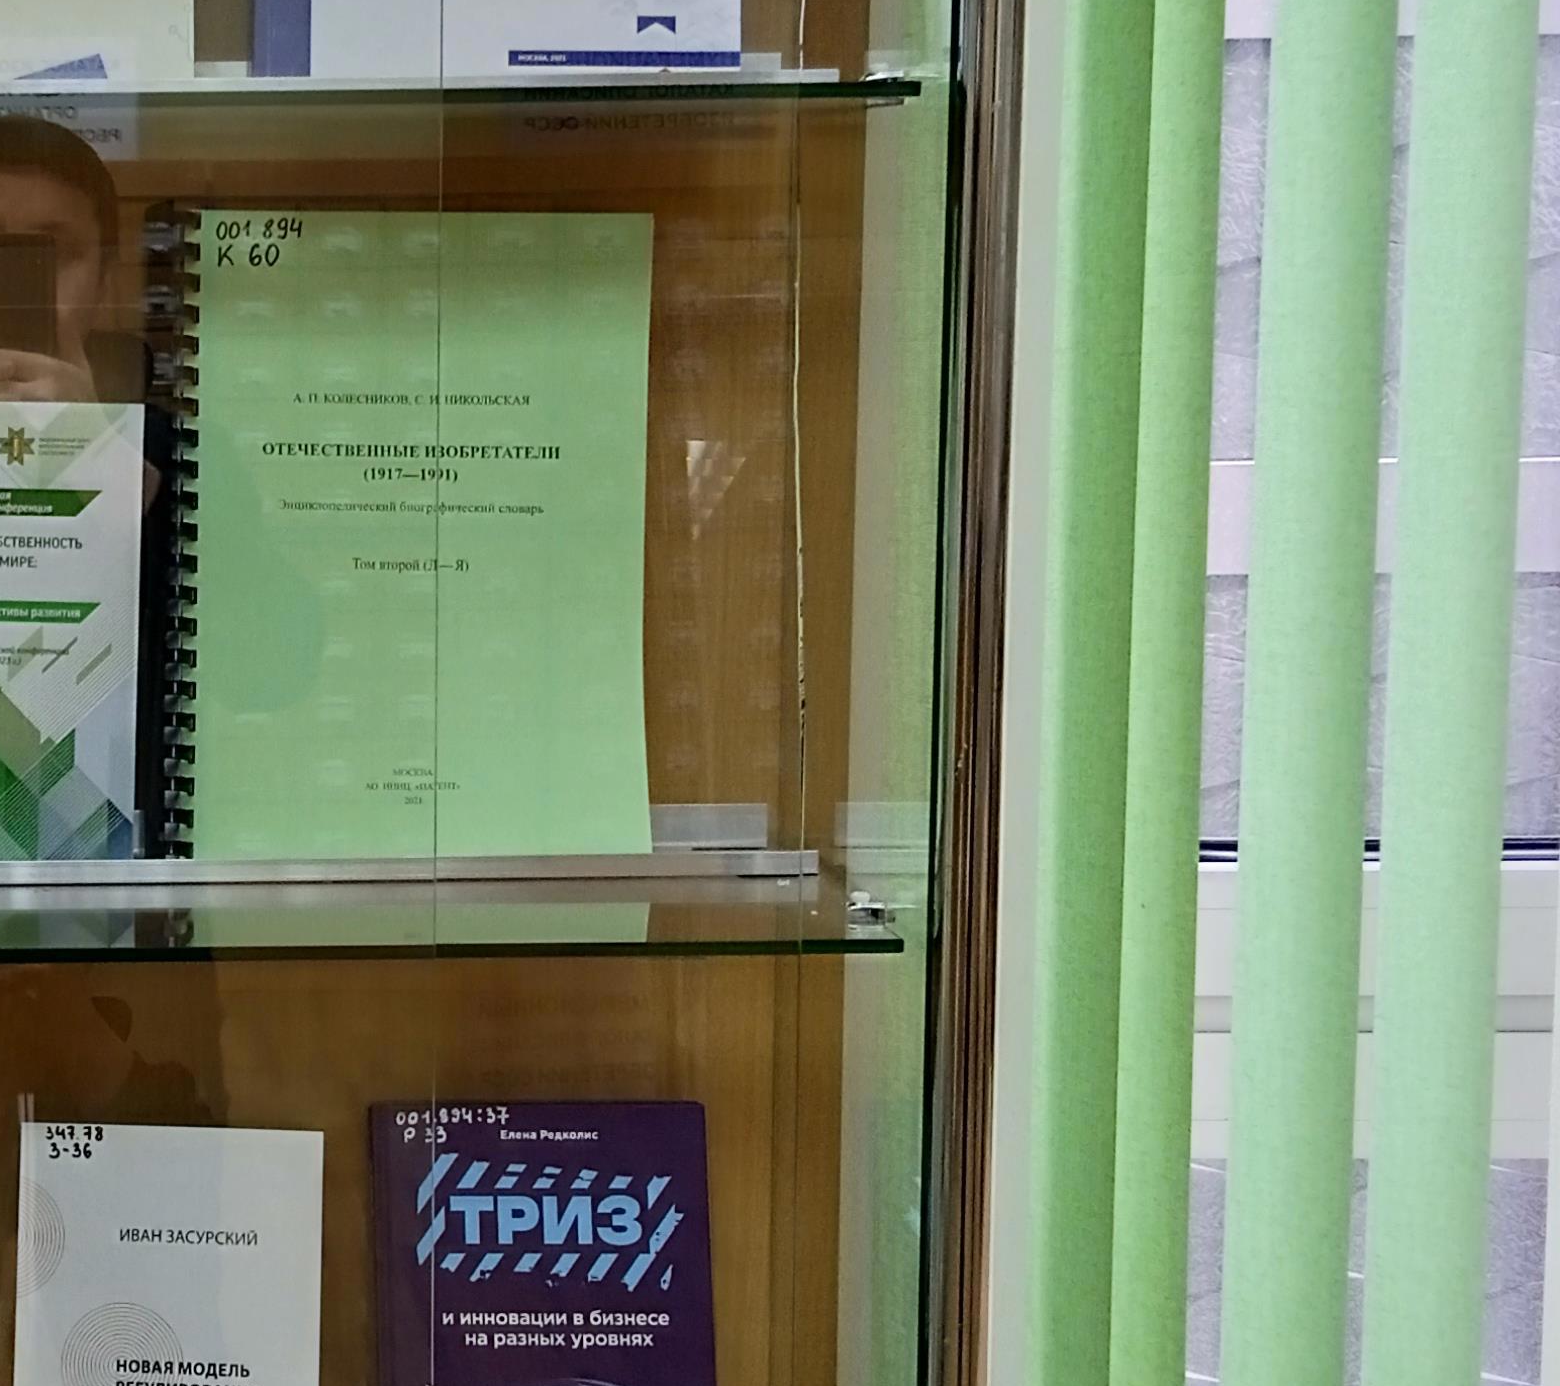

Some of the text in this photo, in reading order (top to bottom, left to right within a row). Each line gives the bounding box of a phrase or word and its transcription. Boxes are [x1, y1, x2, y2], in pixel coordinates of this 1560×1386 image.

[217, 243, 279, 267] К 60
[262, 442, 560, 461] ОТЕЧЕСТВЕННЫЕ ИЗОБРЕТАТЕЛИ
[0, 556, 37, 568] МИРЕ:
[30, 608, 81, 619] развития
[500, 1130, 598, 1141] Елена Редколис
[449, 1195, 642, 1246] ТРИЗ
[120, 1228, 258, 1246] ИВАН ЗАСУРСКИЙ
[443, 1310, 669, 1326] и инновации в бизнесе
[465, 1333, 653, 1348] на разных уровнях
[116, 1360, 250, 1379] НОВАЯ МОДЕЛЬ
